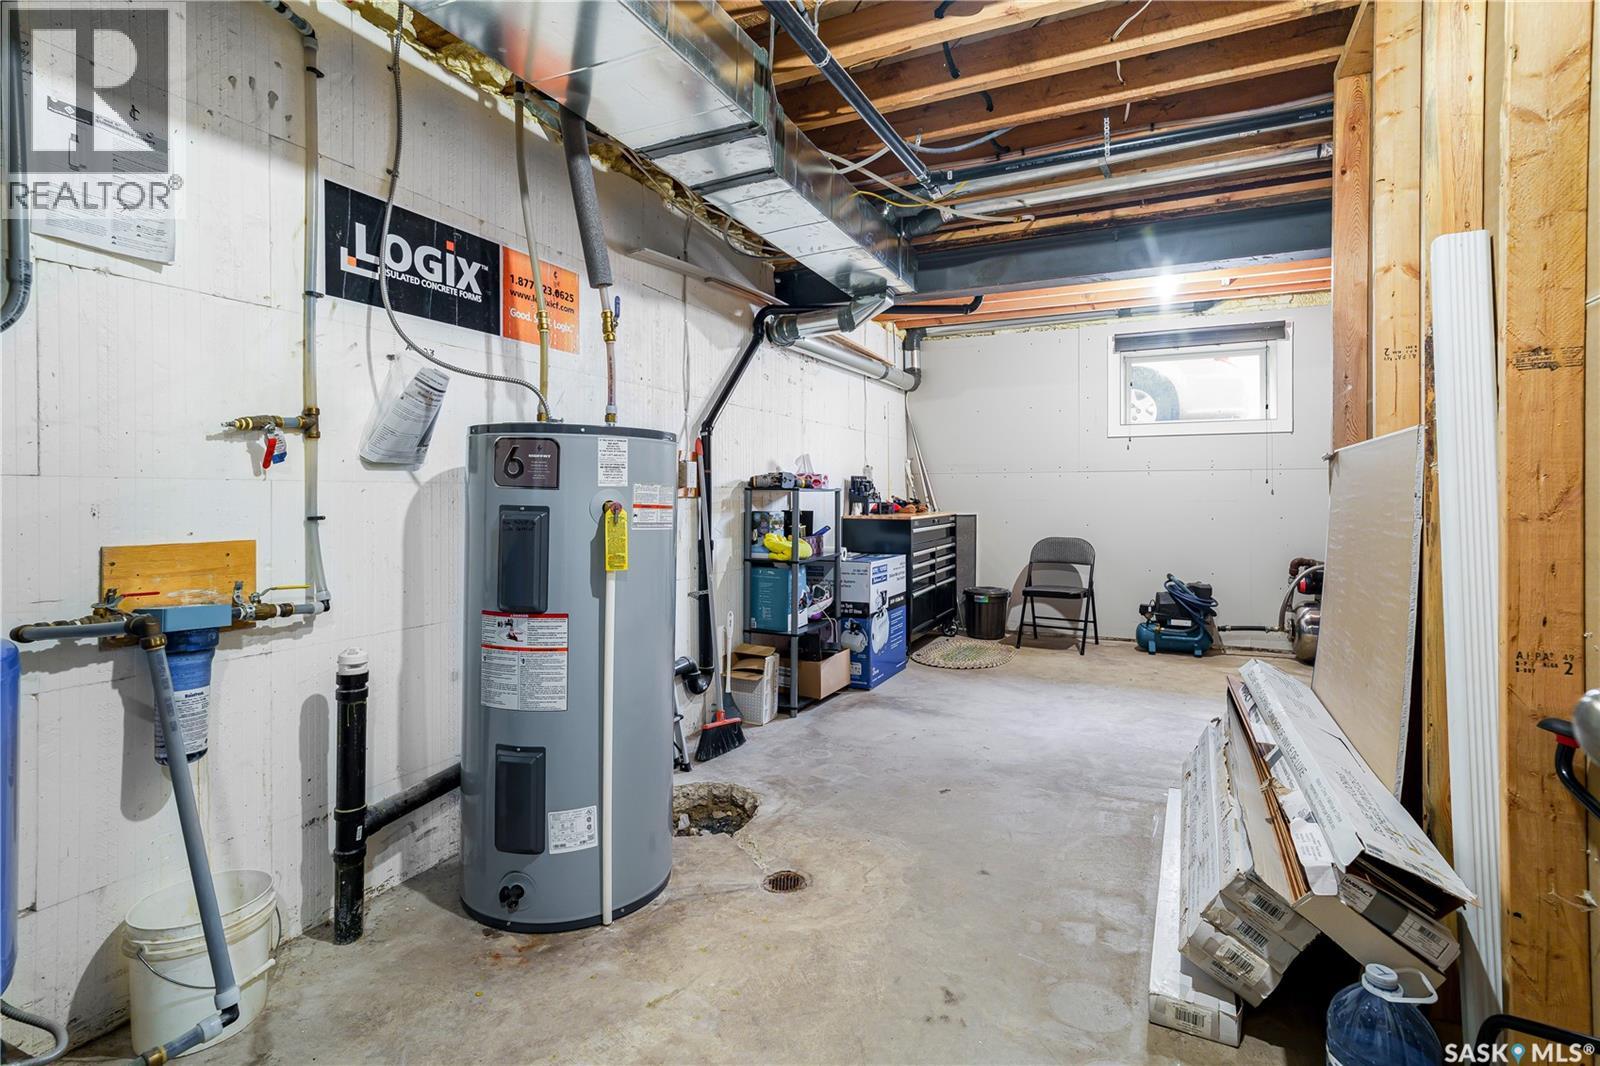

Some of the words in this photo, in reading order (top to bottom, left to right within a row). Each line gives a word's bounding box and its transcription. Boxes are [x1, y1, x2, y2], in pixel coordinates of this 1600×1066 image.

[421, 279, 458, 297] CONCRETE
[458, 289, 483, 303] FORMS
[509, 274, 575, 303] 1.87723.0625
[503, 444, 525, 480] 6
[1563, 661, 1574, 676] 2
